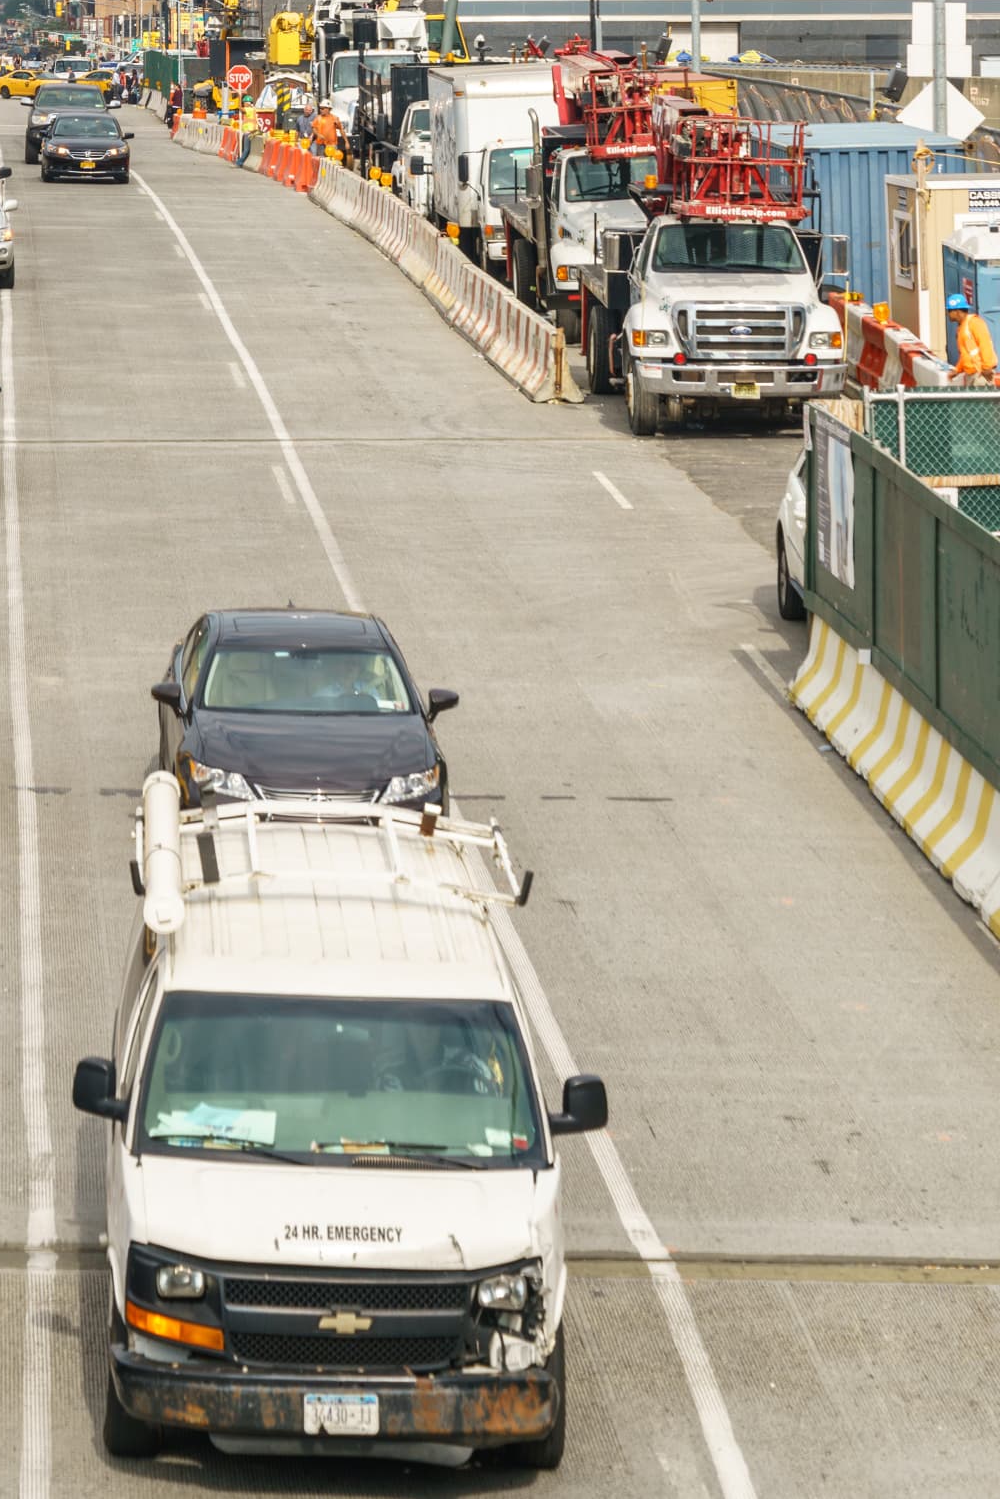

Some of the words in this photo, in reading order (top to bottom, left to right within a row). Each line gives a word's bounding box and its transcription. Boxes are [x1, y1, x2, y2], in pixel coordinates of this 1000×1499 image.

[229, 73, 250, 83] STOP
[705, 205, 788, 218] ElliottEquip.com
[284, 1224, 299, 1240] 24
[302, 1225, 323, 1240] HR.
[327, 1225, 403, 1243] EMERGENCY
